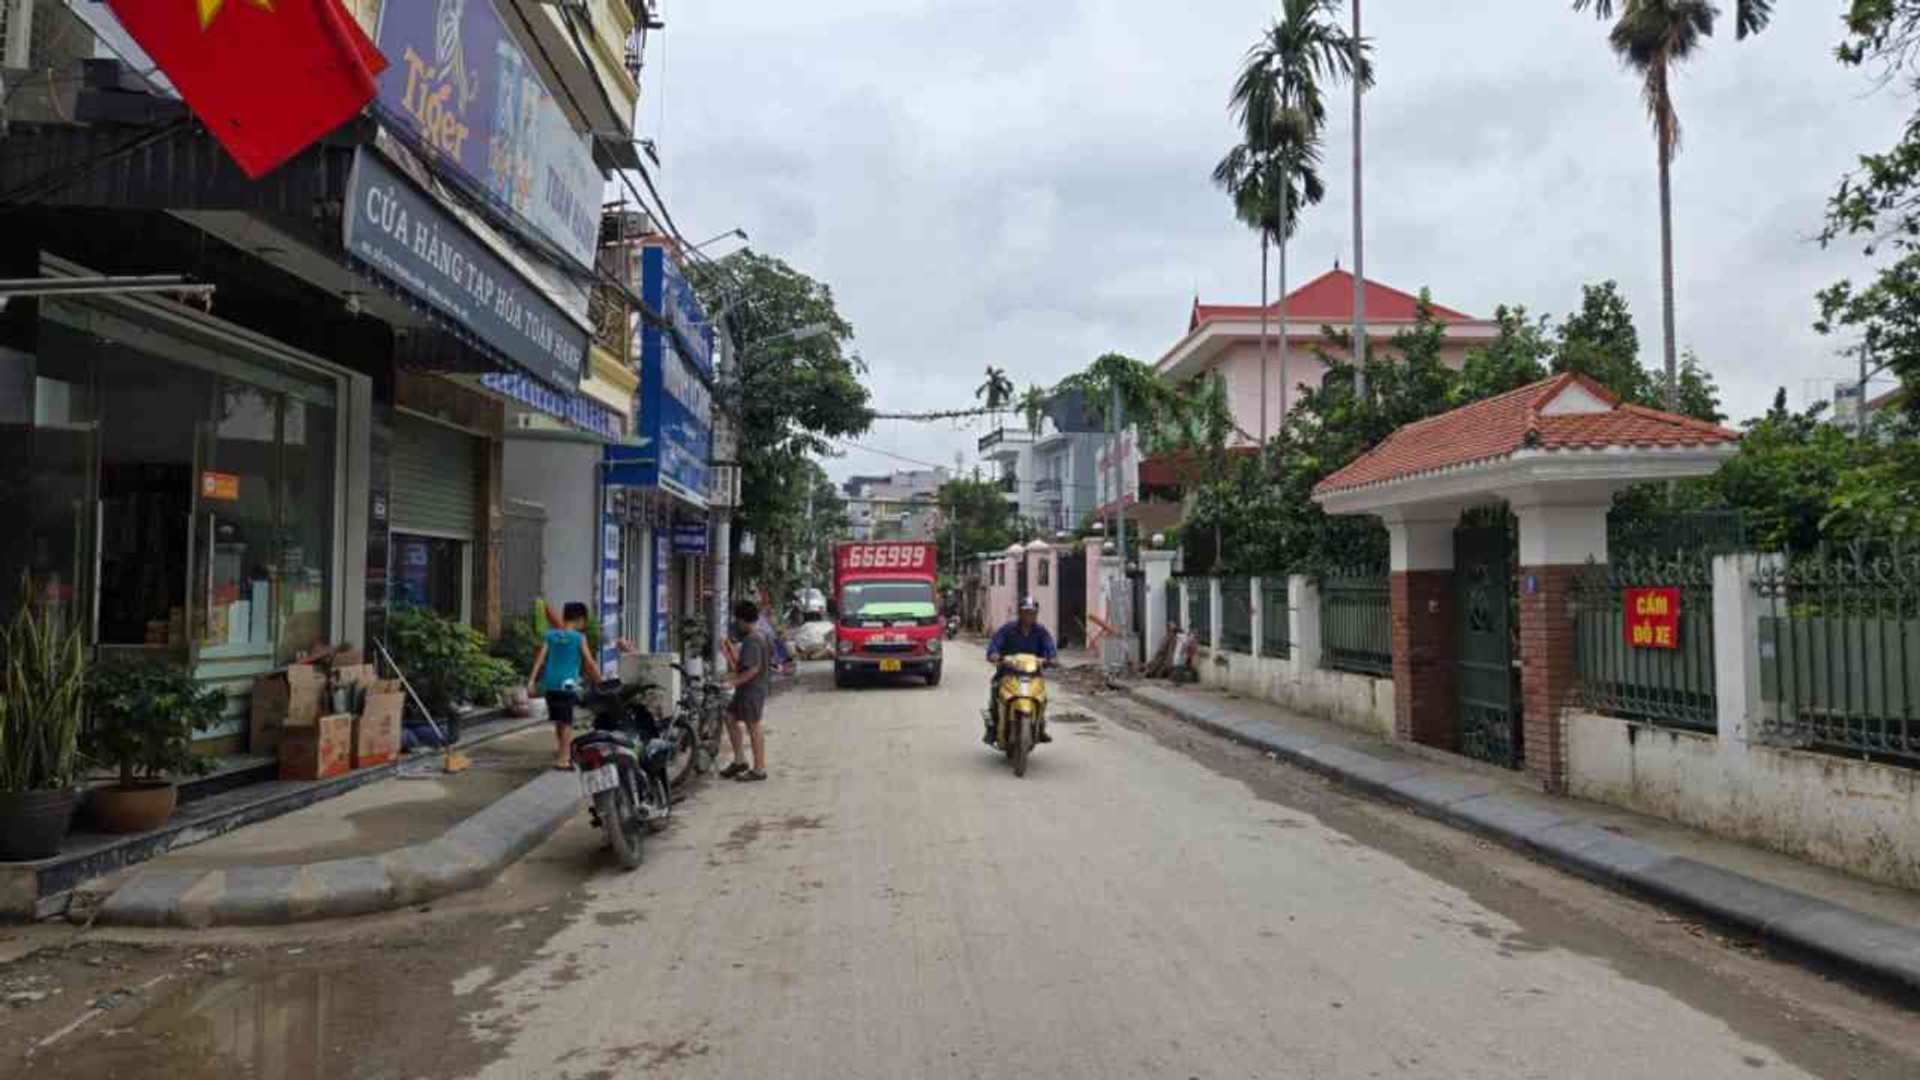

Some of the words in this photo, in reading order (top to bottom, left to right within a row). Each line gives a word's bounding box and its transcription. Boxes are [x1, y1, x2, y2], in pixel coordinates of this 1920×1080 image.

[402, 48, 469, 166] Tiger
[366, 186, 408, 246] CỬA
[413, 221, 463, 283] HÀNG
[467, 262, 495, 307] TẠP
[849, 545, 926, 568] 666999
[1636, 590, 1668, 616] CẤM
[1656, 626, 1671, 645] XE
